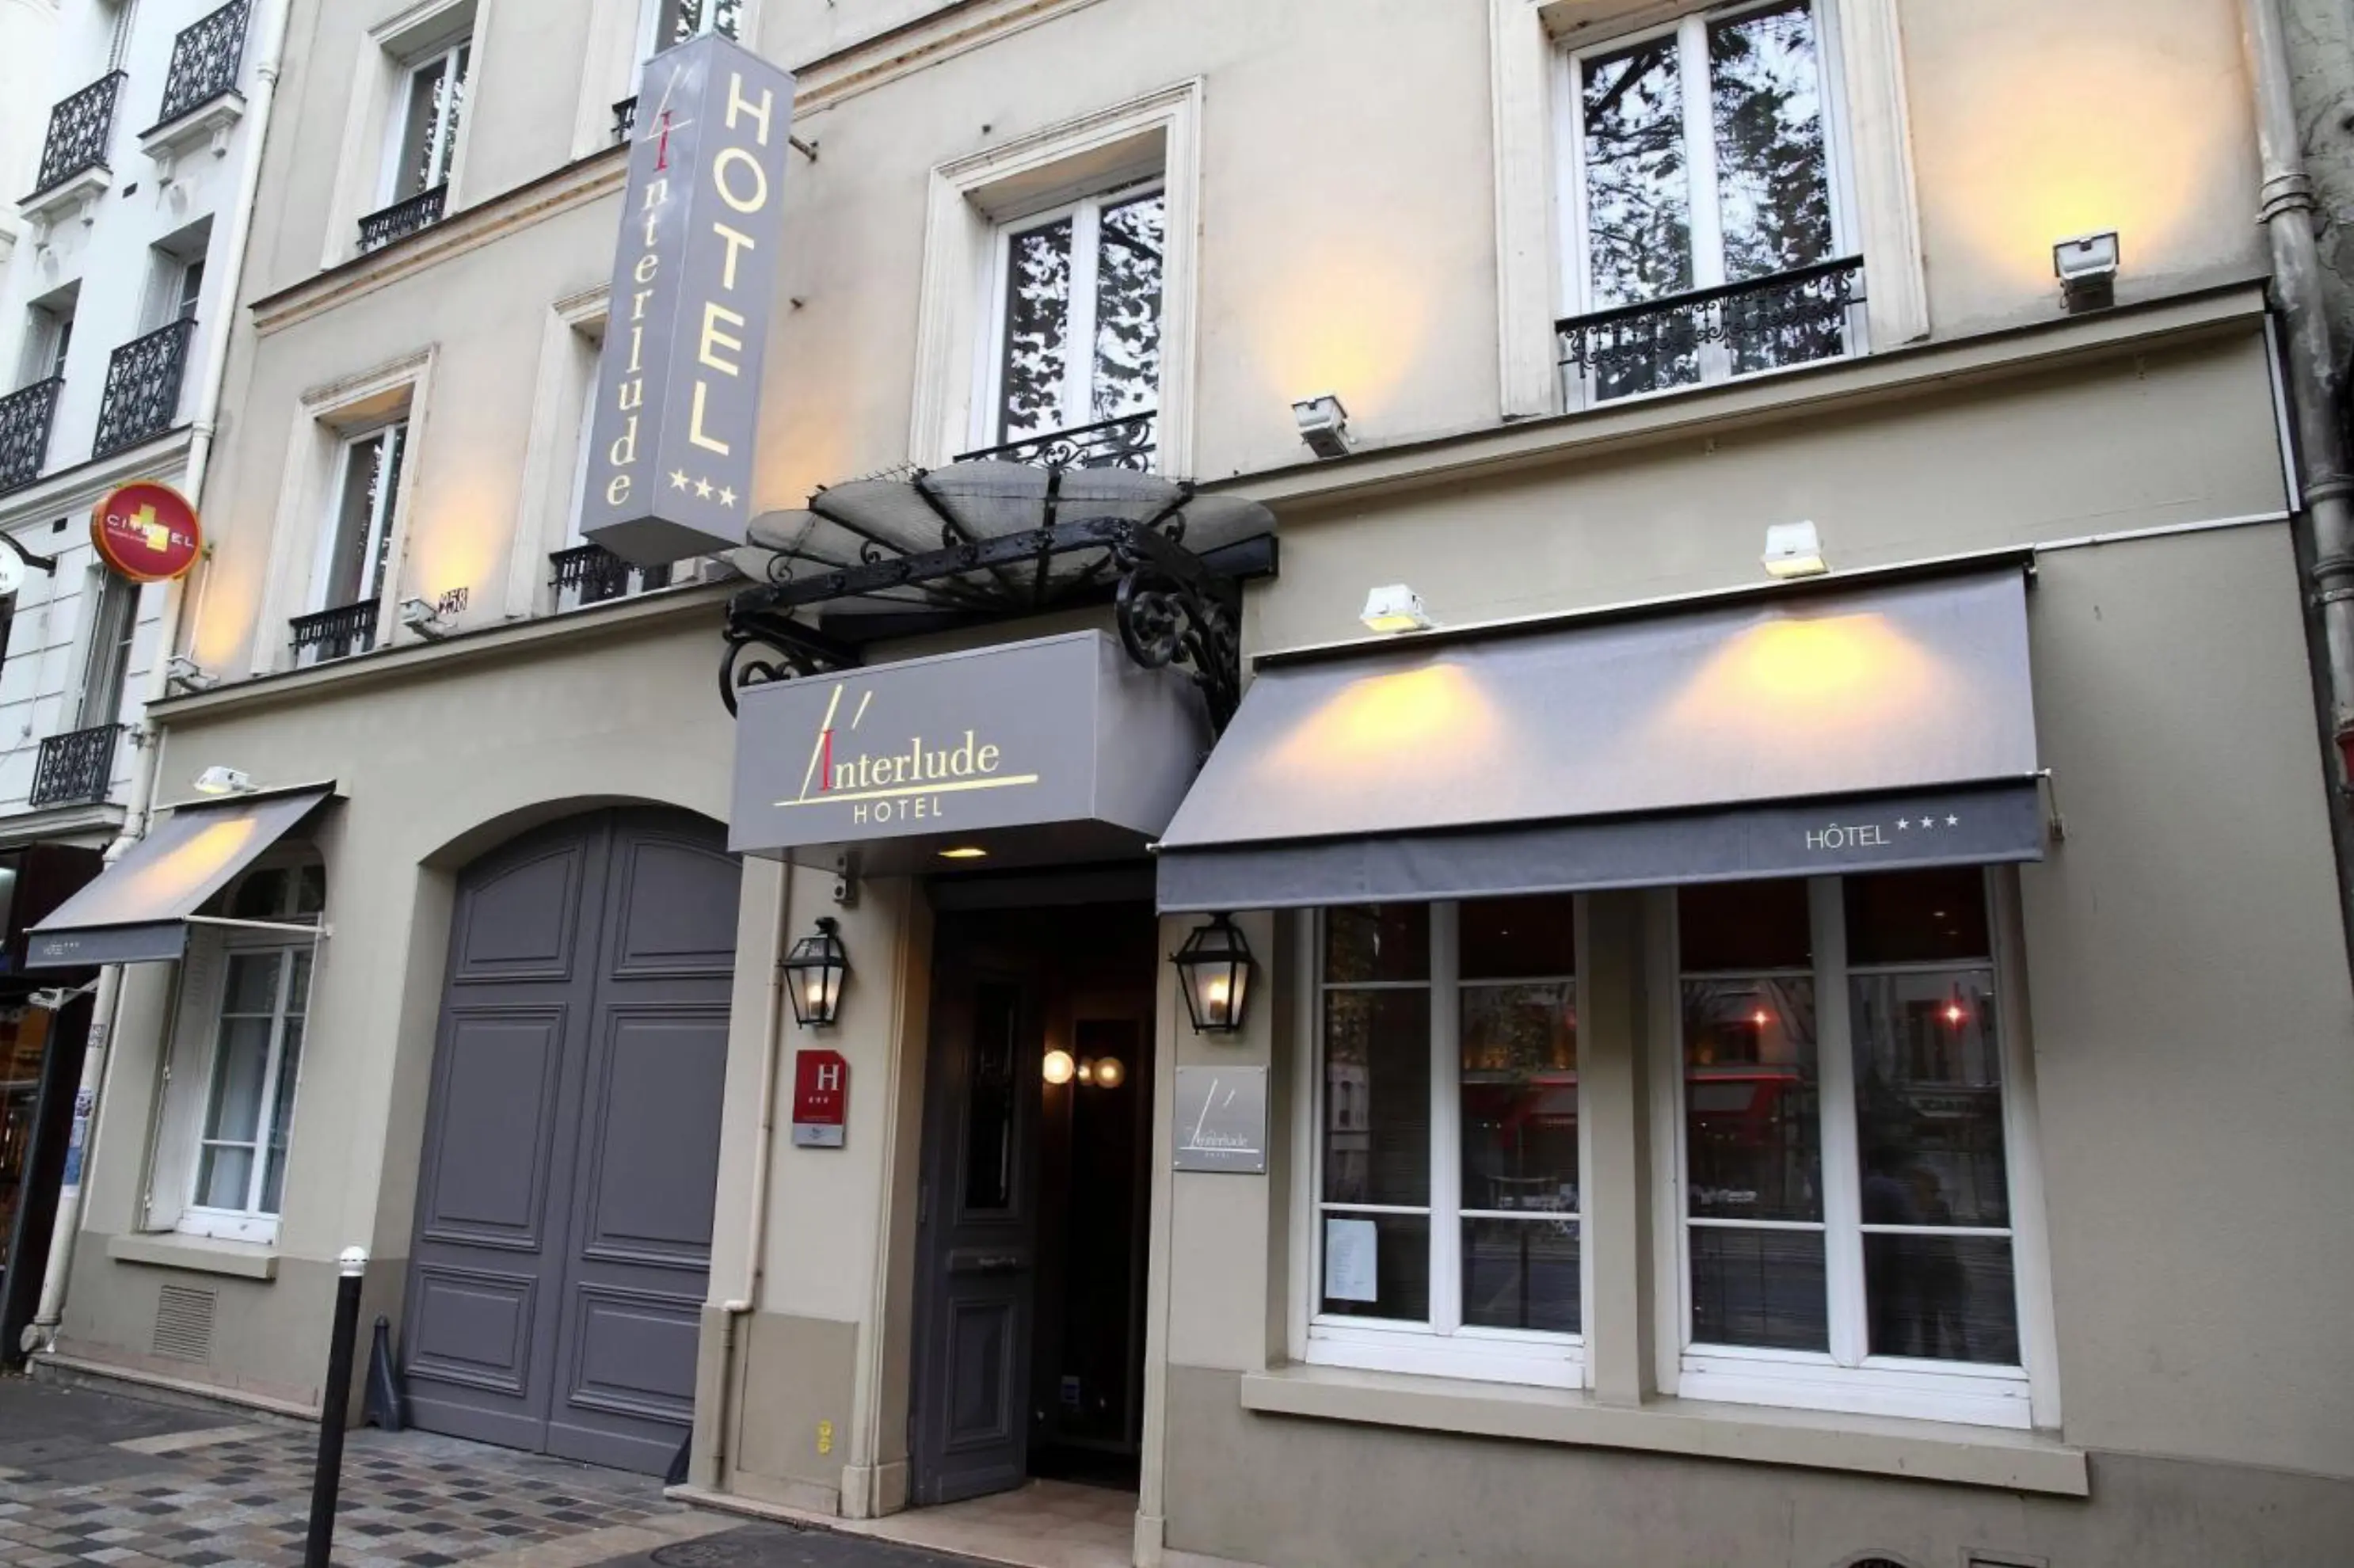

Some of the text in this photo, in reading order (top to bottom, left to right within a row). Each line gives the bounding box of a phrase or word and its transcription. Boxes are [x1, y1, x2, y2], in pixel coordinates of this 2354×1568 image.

[687, 72, 774, 456] HOTEL
[854, 796, 943, 824] HOTEL
[1806, 823, 1892, 850] HÔTEL
[817, 1064, 840, 1090] H
